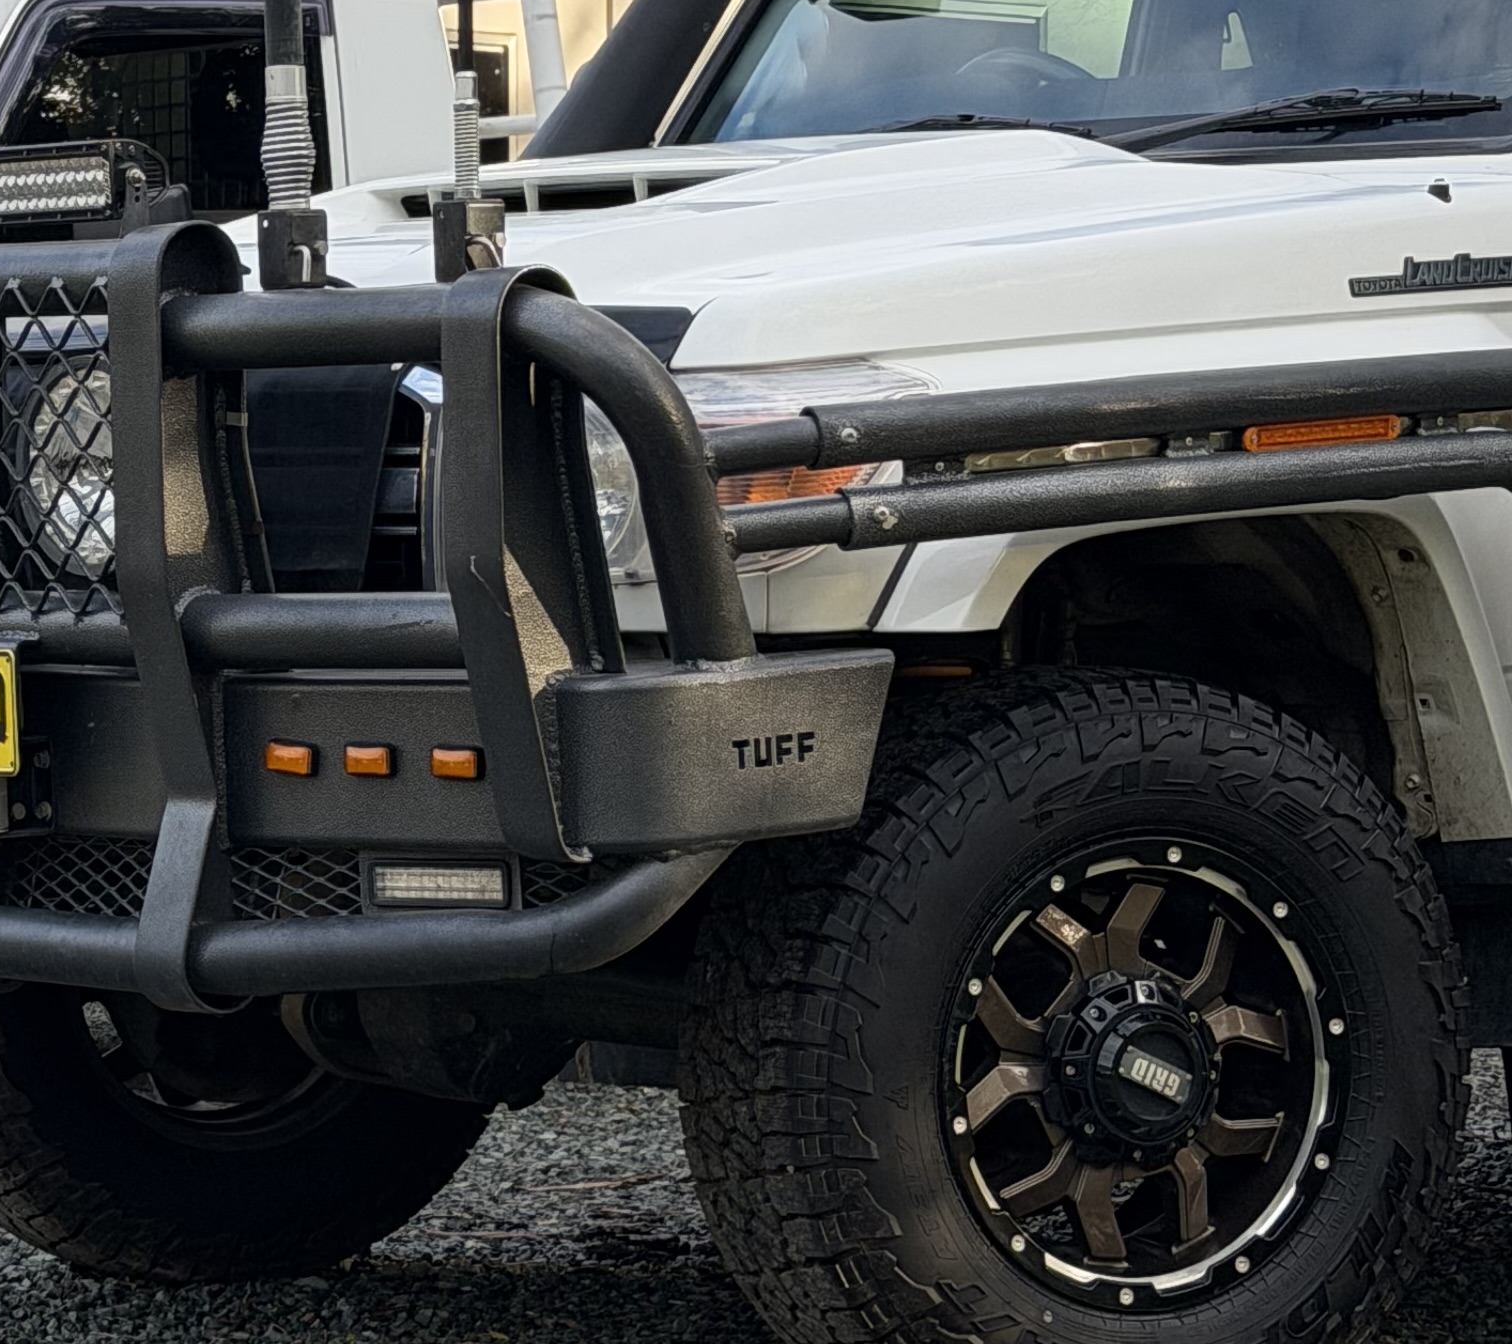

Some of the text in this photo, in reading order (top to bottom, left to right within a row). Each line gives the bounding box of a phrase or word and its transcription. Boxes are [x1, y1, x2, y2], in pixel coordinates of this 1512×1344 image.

[1353, 278, 1403, 294] TOYOTA
[731, 731, 816, 770] TUFF
[1130, 1057, 1181, 1097] GRID
